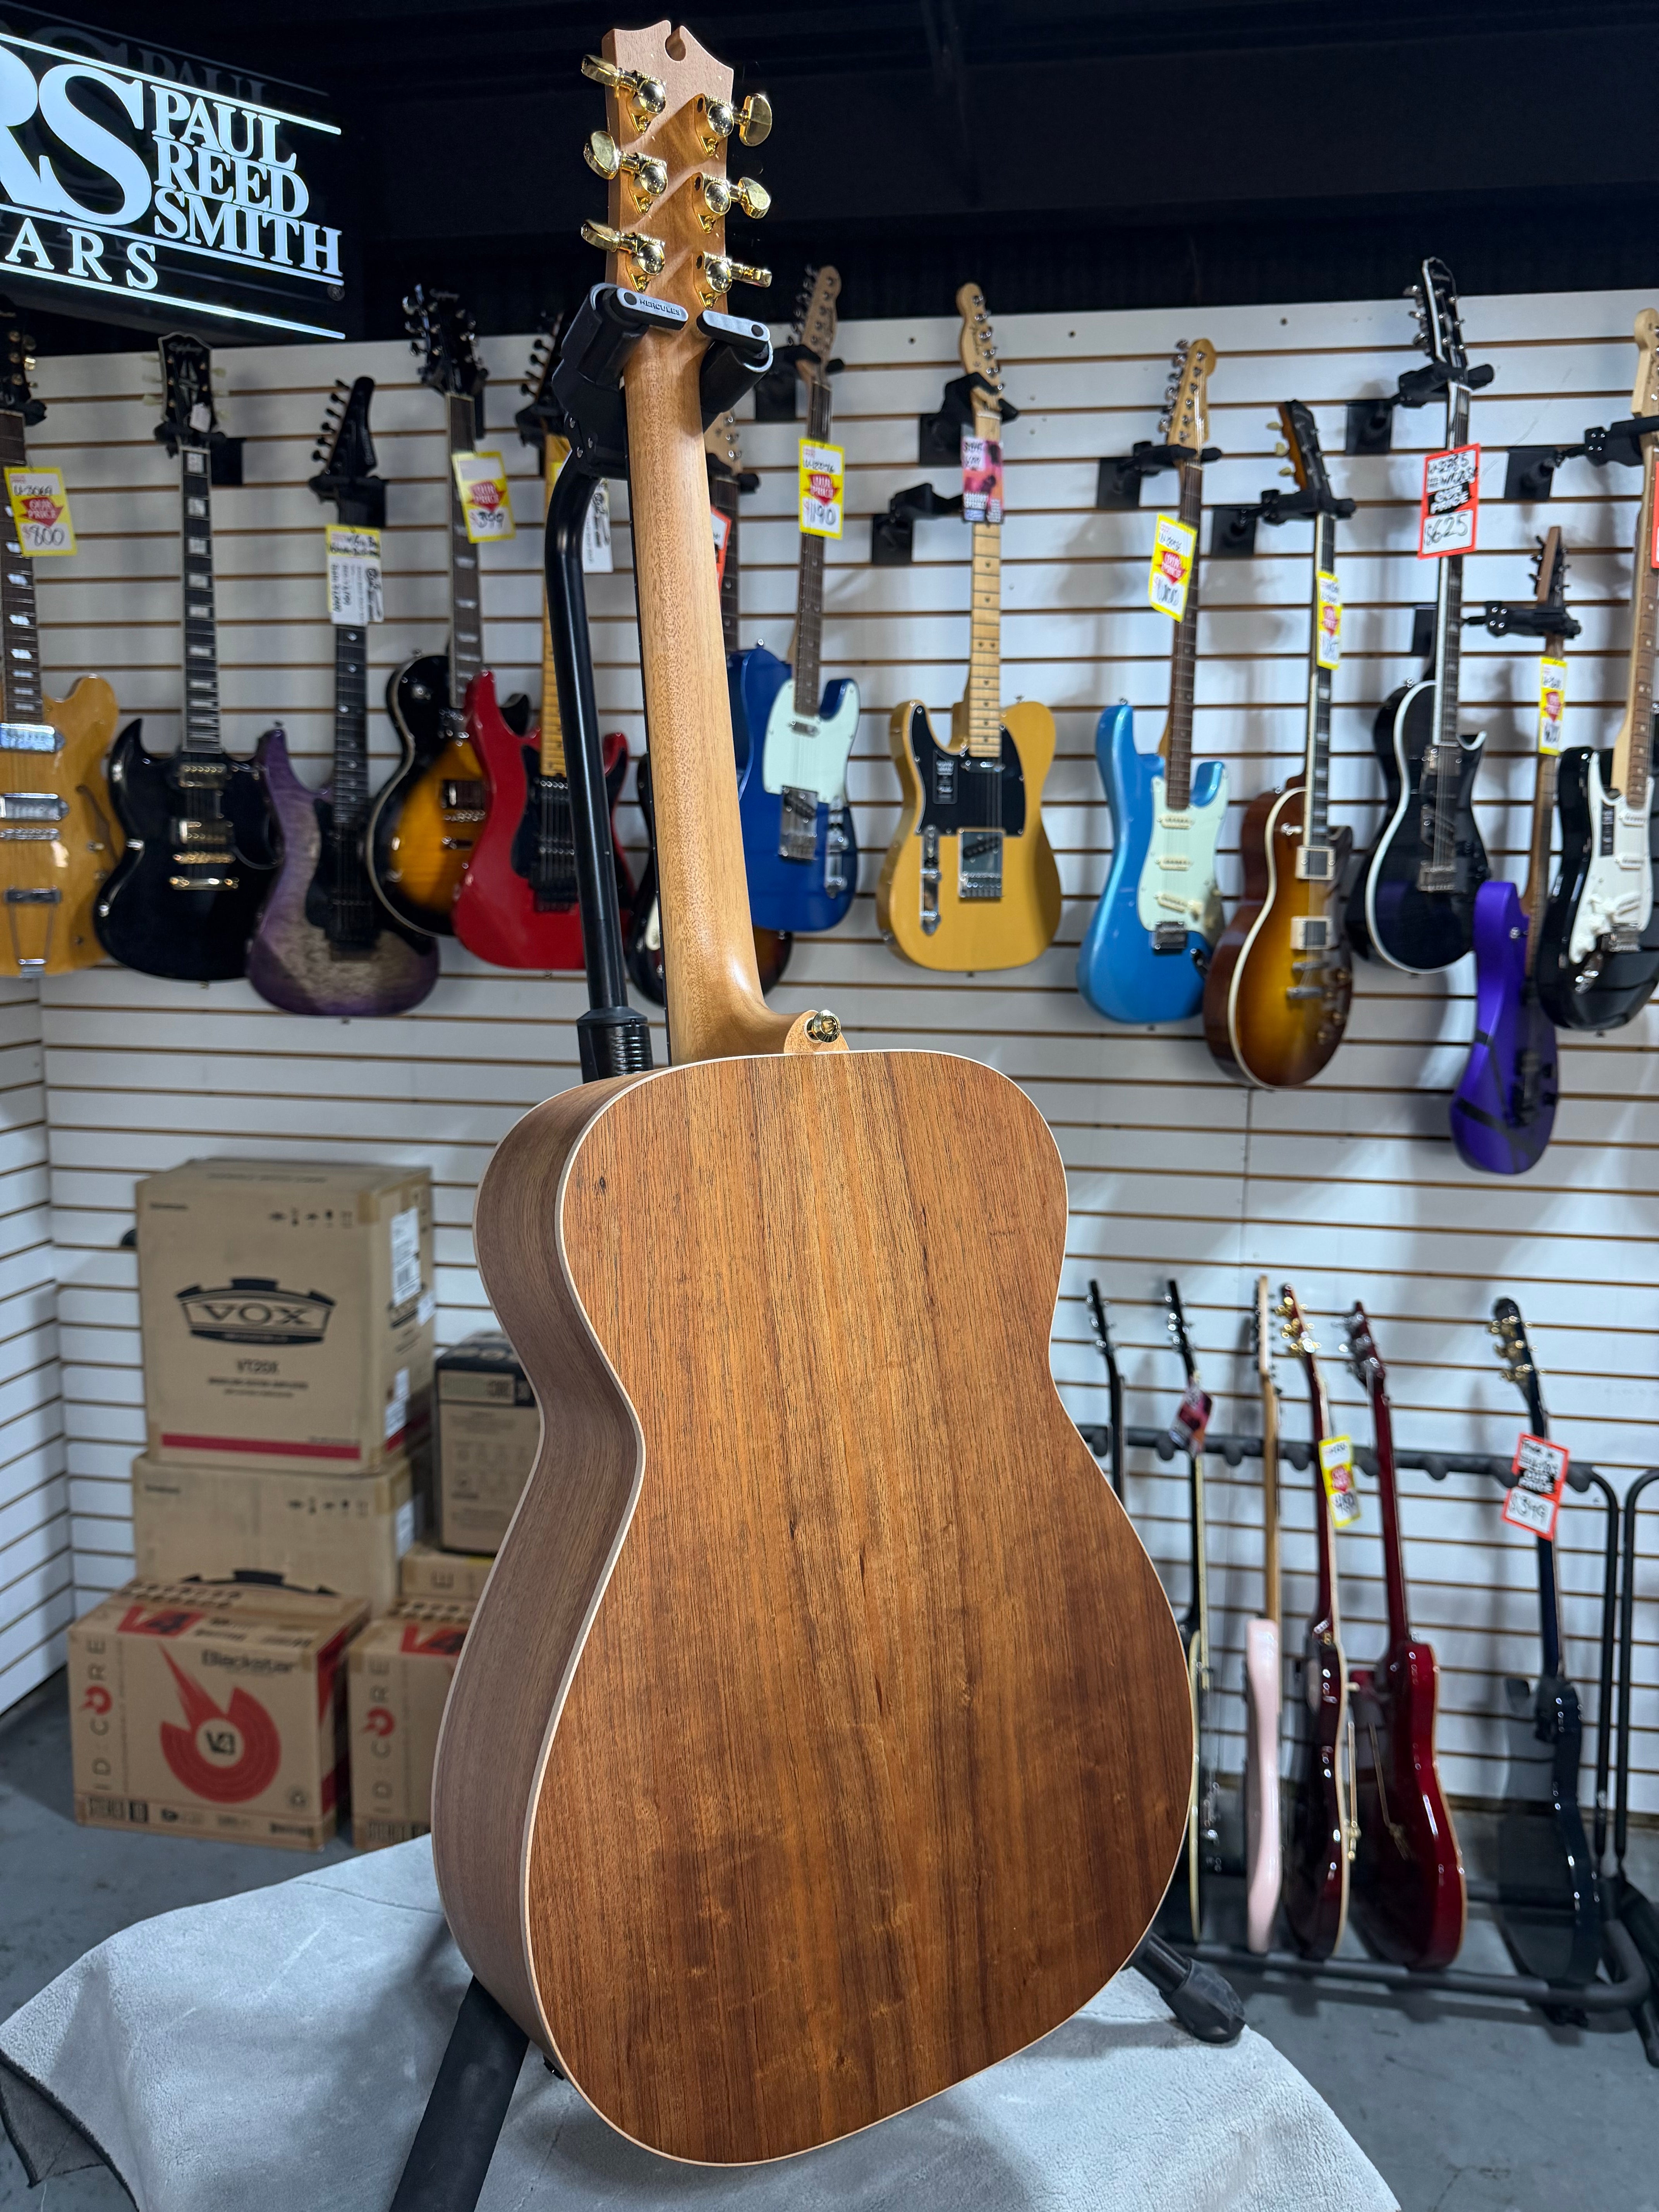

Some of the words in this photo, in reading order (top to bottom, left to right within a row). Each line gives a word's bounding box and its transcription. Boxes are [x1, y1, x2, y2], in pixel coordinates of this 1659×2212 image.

[150, 85, 296, 171] PAUL
[151, 135, 309, 218] REED
[155, 189, 344, 278] SMITH
[639, 298, 680, 316] HERCULES
[29, 498, 51, 510] OUR
[1430, 491, 1469, 514] PRICE
[1434, 484, 1463, 502] OUR
[27, 510, 57, 519] PRICE
[1424, 514, 1468, 546] $625
[202, 1302, 312, 1326] VOX
